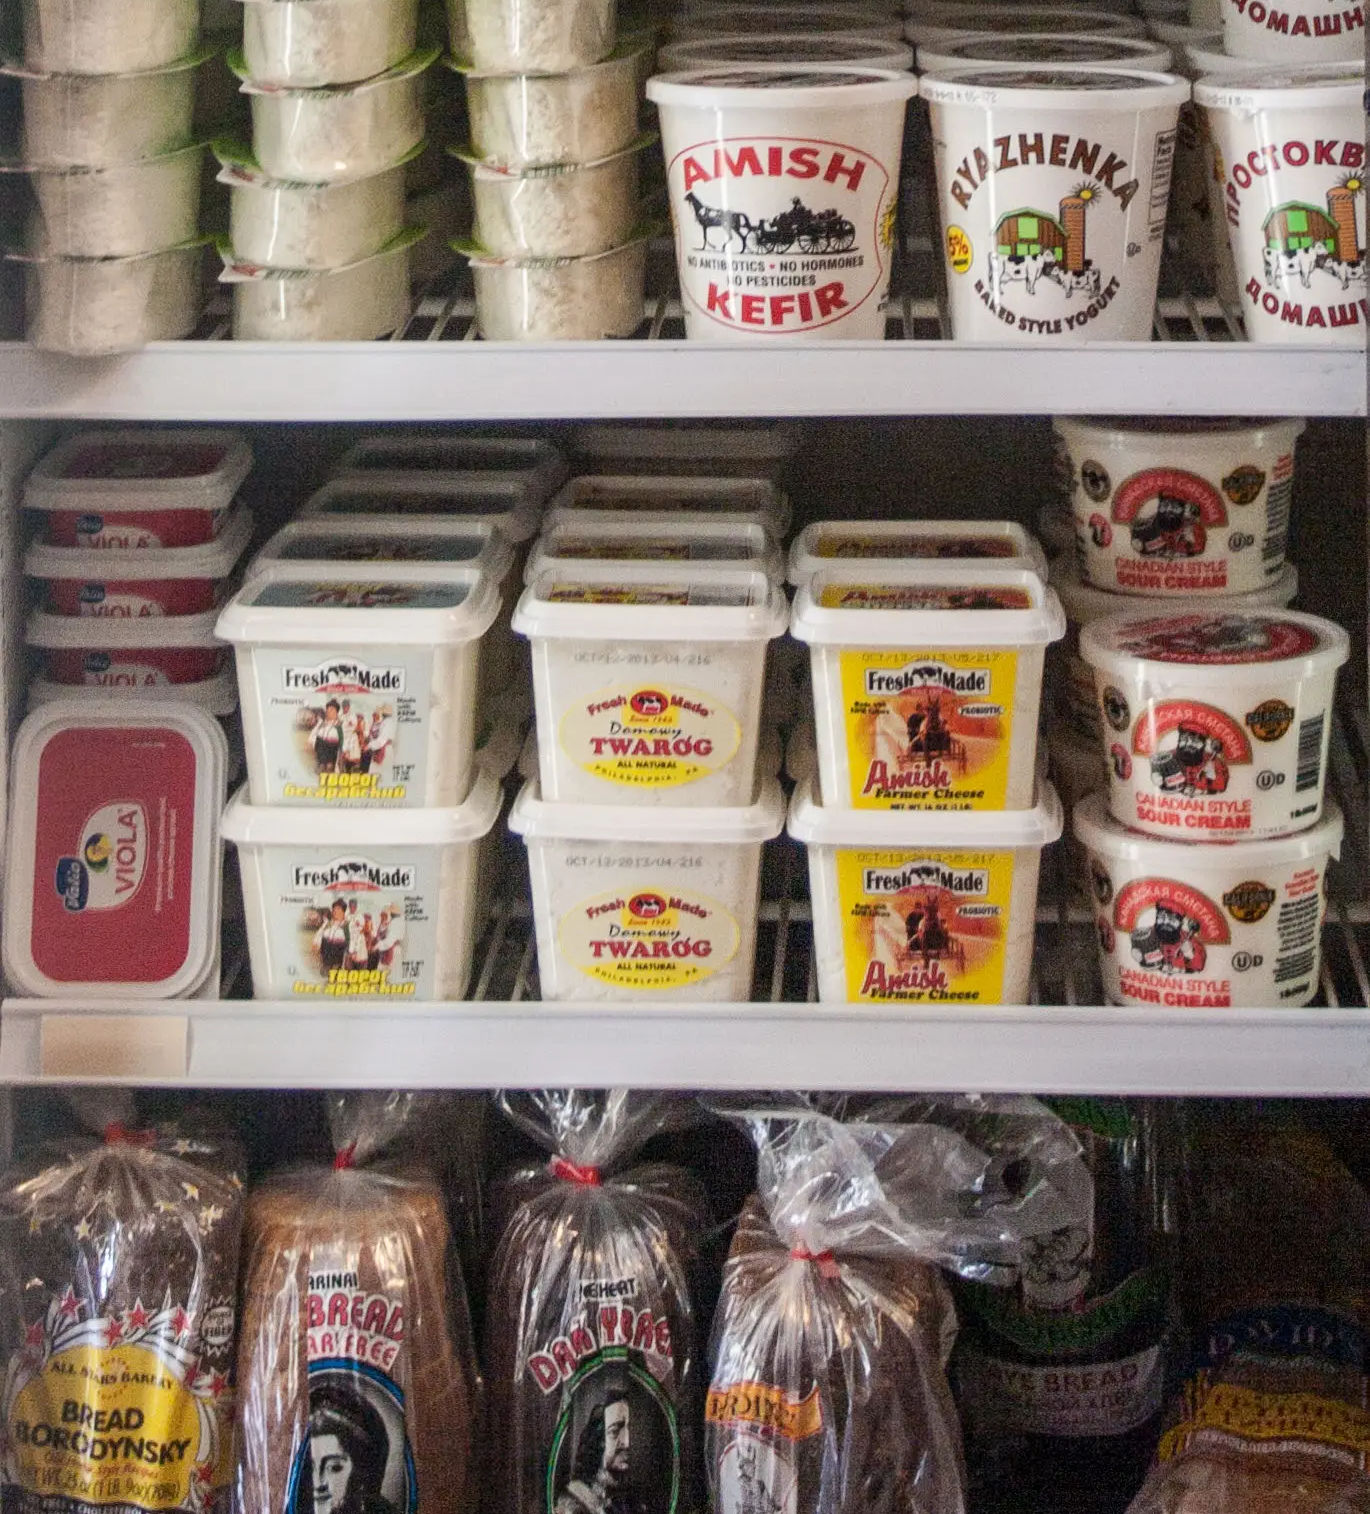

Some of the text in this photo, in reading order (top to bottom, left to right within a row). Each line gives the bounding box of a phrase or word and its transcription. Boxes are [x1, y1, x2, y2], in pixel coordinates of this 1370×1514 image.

[683, 146, 866, 191] AMISH
[951, 133, 1139, 212] RYAZHENKA
[699, 260, 765, 272] ANTIBOTICS
[780, 262, 797, 272] NO
[801, 255, 865, 270] HORMONES
[746, 273, 817, 286] PESTICIDES
[707, 281, 849, 326] KEFIR
[974, 276, 1121, 334] BAKED STYLE YOGURT
[286, 669, 401, 689] Fresh Made
[868, 670, 985, 691] Fresh Made
[586, 695, 710, 717] Fresh Made
[609, 721, 683, 739] Domowy
[590, 735, 713, 756] TWARÓG
[617, 760, 677, 769] ALL NATURAL
[863, 759, 951, 794] Amish
[875, 789, 984, 799] Farmer Cheese
[1136, 805, 1252, 829] SOUR CREAM
[1208, 799, 1251, 813] STYLE
[116, 809, 139, 894] VIOLA
[295, 867, 411, 886] Fresh Made
[866, 870, 984, 891] Fresh Made
[586, 897, 708, 919] Fresh Made
[609, 924, 681, 940] Domowy
[589, 937, 713, 958] TWARÓG
[617, 962, 677, 971] ALL NATURAL
[861, 960, 948, 994] Amish
[1118, 966, 1230, 992] CANADIAN STYLE
[870, 990, 979, 1000] Farmer Cheese
[1119, 980, 1231, 1007] SOUR CREAM
[345, 1335, 397, 1365] FREE
[1045, 1364, 1138, 1392] BREAD
[62, 1399, 145, 1432] BREAD
[16, 1420, 192, 1465] BORODYNSKY
